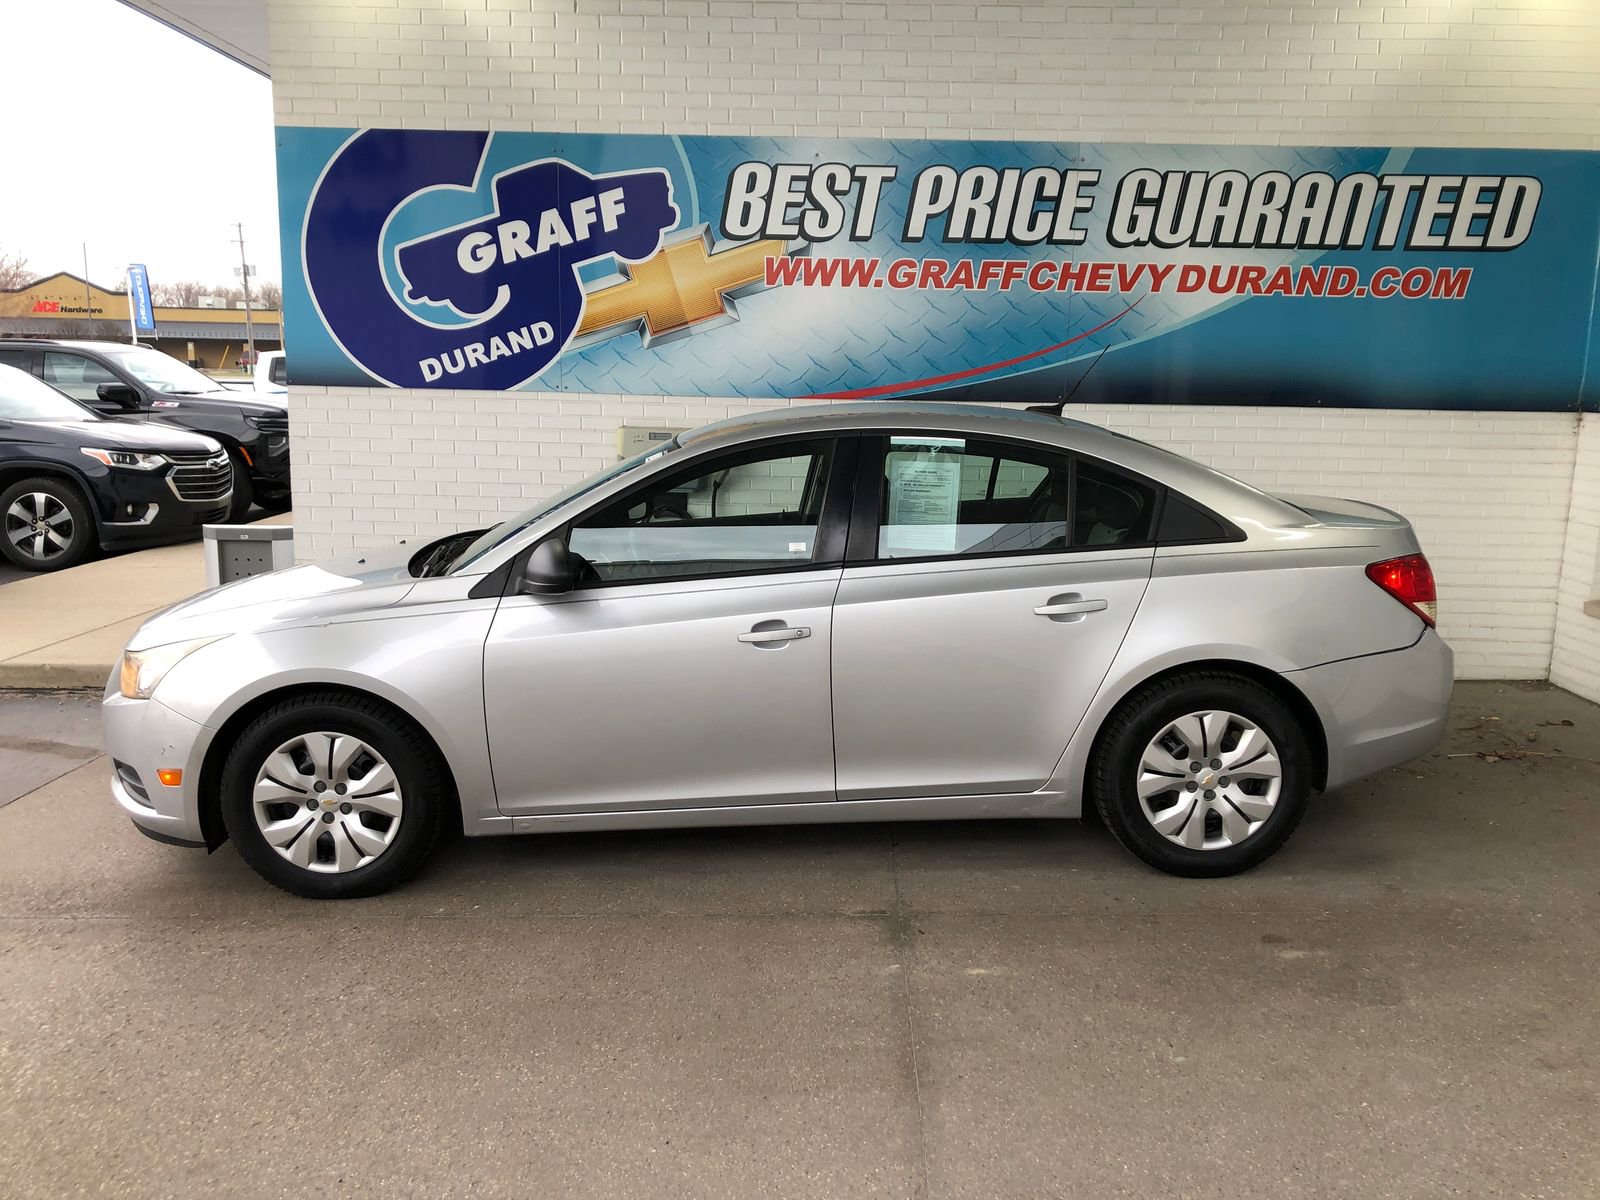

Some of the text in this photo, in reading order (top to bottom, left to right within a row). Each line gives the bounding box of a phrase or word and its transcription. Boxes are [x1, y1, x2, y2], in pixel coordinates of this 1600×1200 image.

[456, 186, 626, 274] GRAFF
[719, 161, 1544, 252] BEST PRICE GUARANTEED
[32, 300, 104, 314] ACE Hardware
[763, 255, 1474, 300] WWW.GRAFFCHEVYDURAND.COM
[418, 320, 555, 383] DURAND
